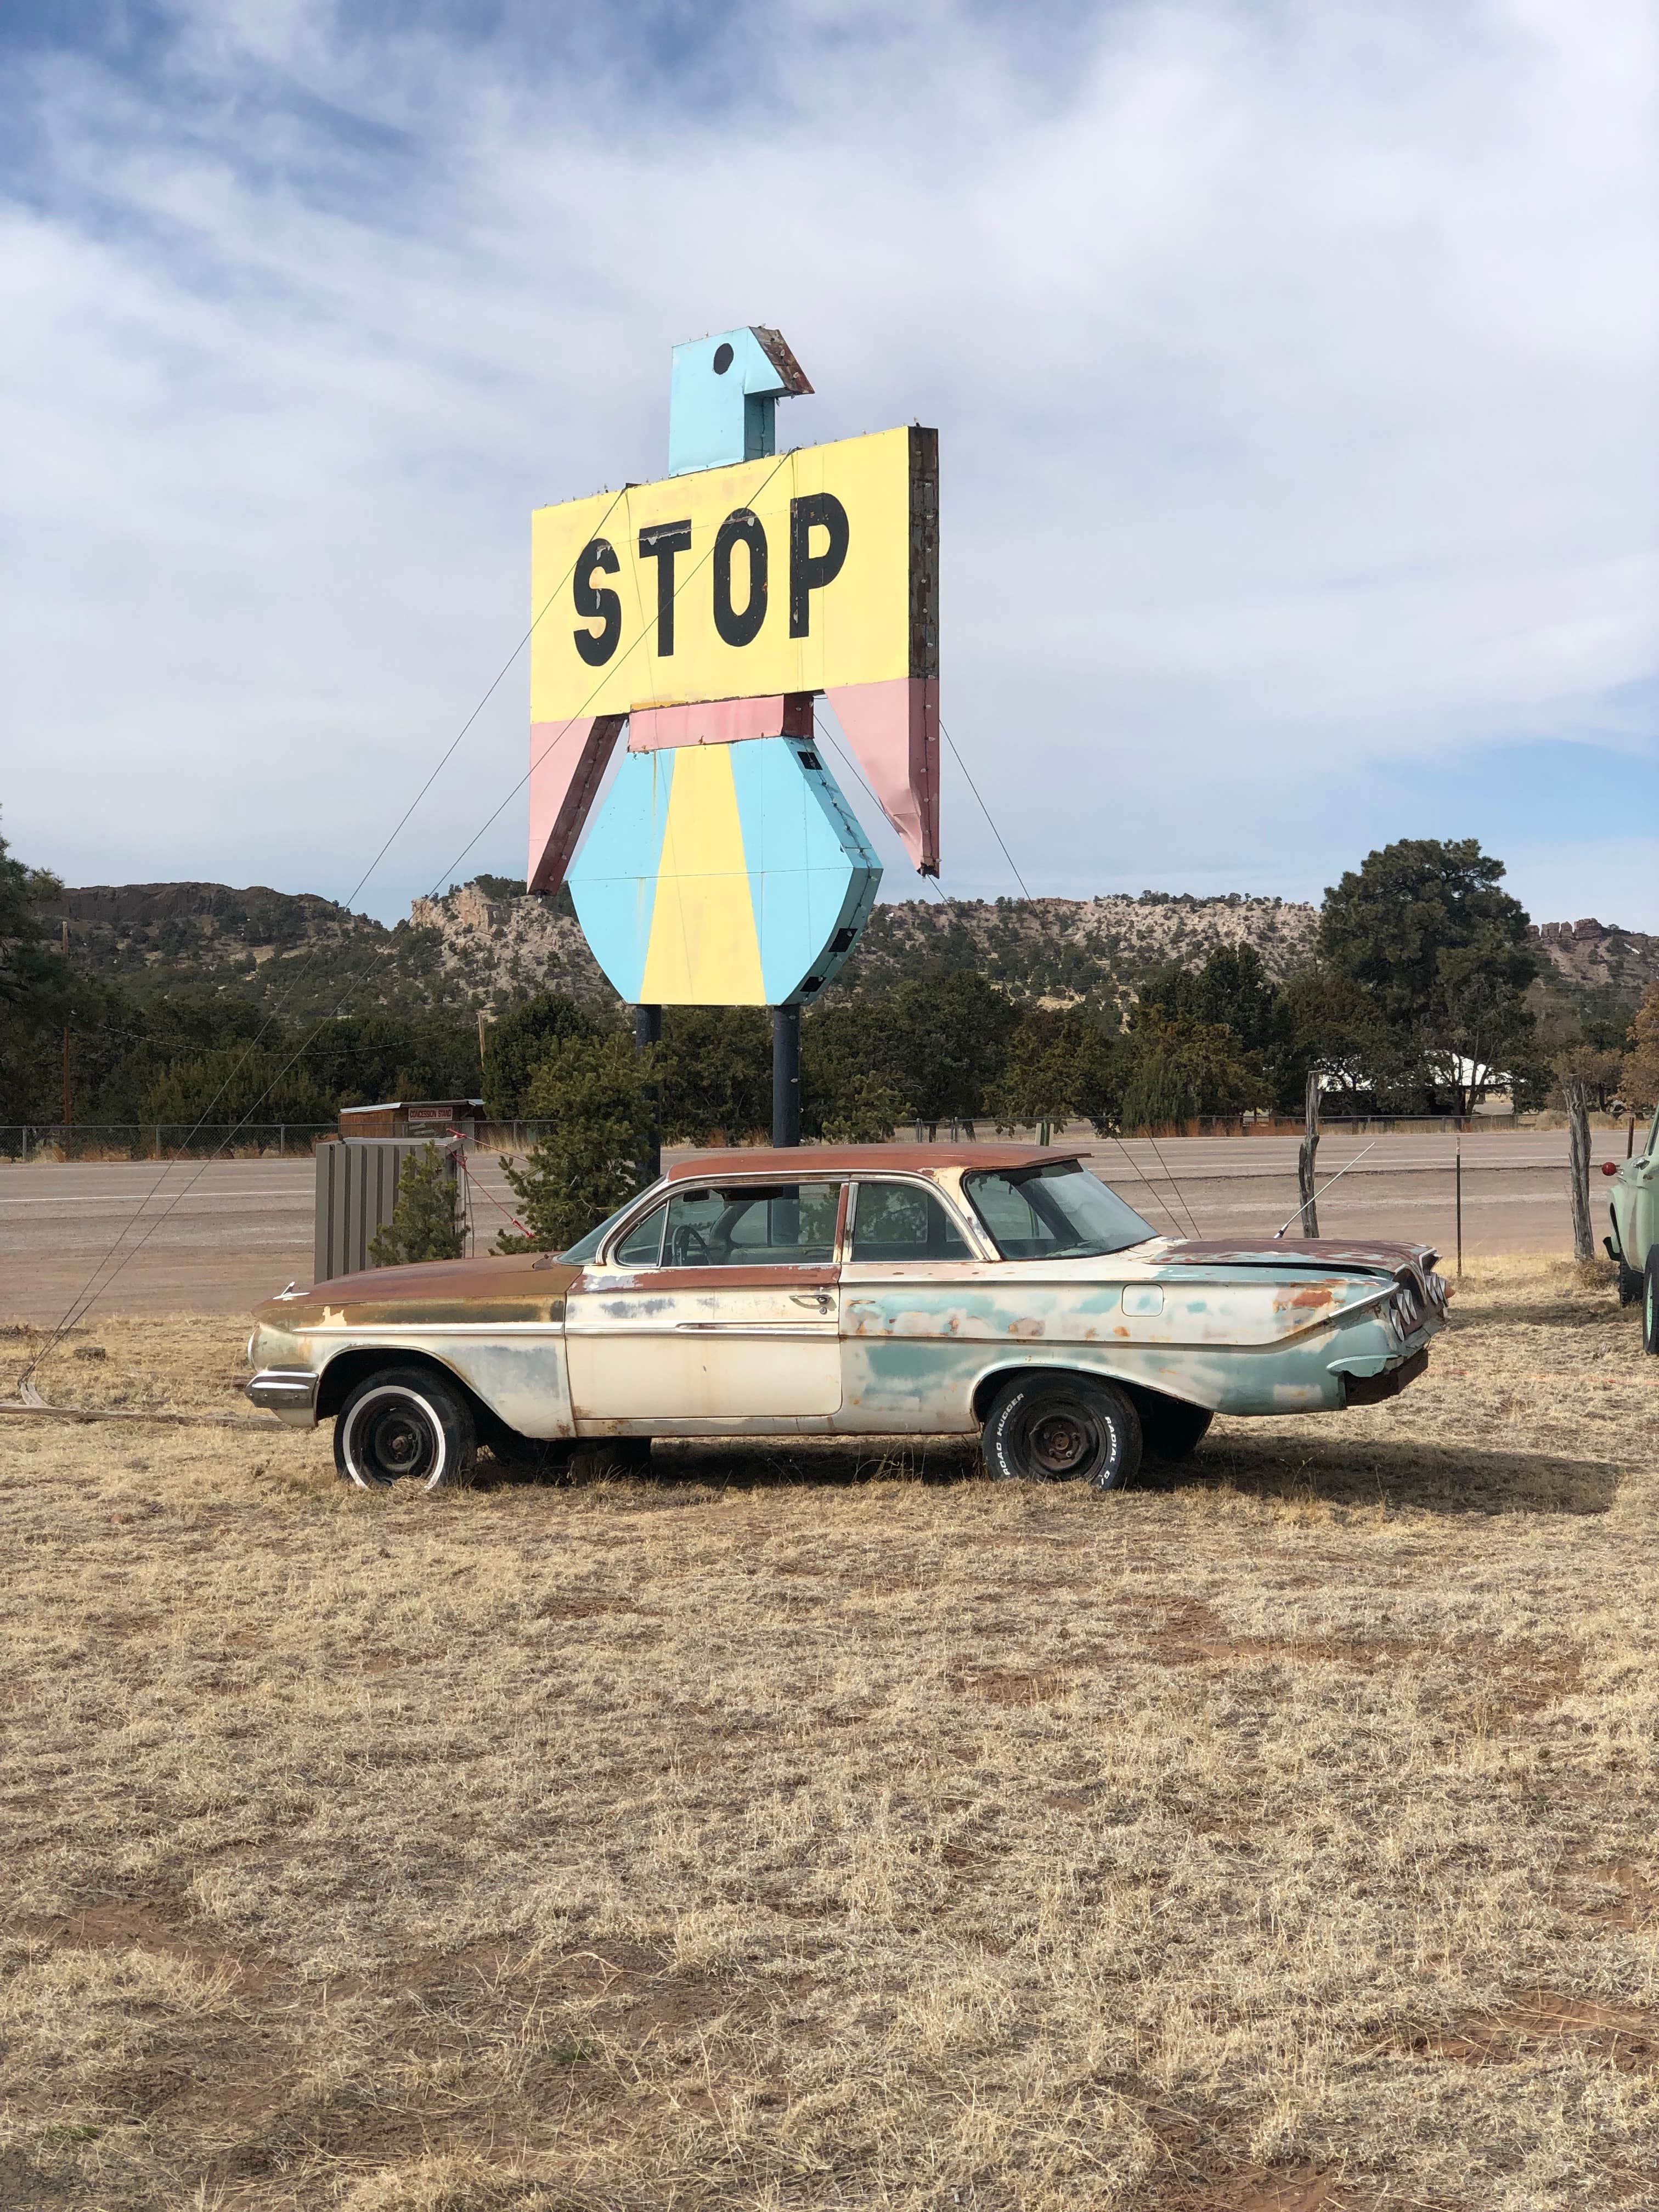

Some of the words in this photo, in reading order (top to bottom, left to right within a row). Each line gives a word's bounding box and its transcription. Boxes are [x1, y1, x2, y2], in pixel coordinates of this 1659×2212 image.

[573, 493, 849, 667] STOP
[410, 1109, 437, 1118] CONCESSION
[438, 1109, 452, 1118] STAND
[996, 1393, 1024, 1436] HUGGER
[996, 1442, 1011, 1475] ROAD
[1105, 1417, 1117, 1463] RADIAL
